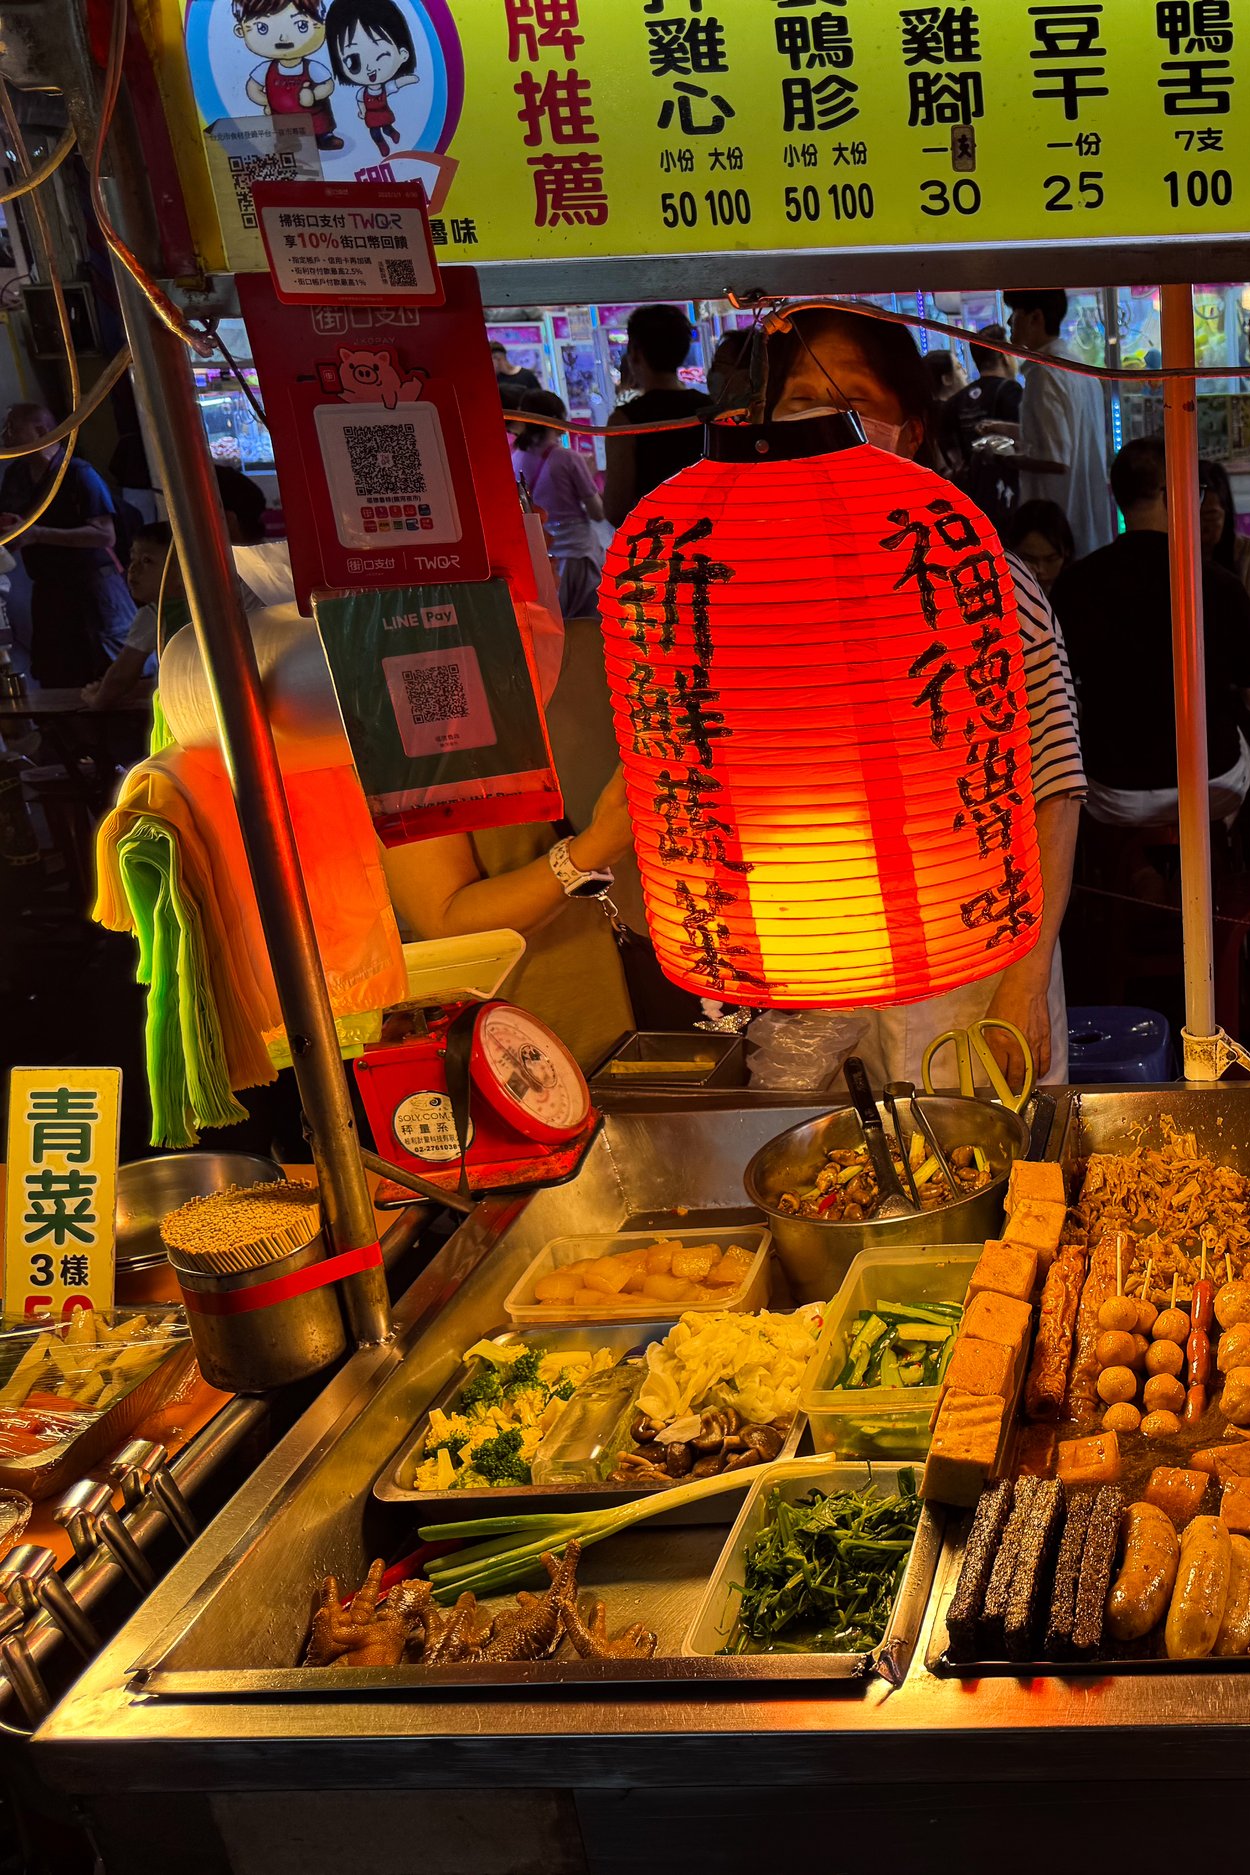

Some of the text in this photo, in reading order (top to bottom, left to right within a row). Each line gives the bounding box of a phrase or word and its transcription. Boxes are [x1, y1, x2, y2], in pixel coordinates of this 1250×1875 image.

[644, 0, 735, 135] 雞心
[775, 0, 859, 132] 鴨胗
[899, 6, 984, 127] 雞腳
[1027, 4, 1109, 120] 豆干
[1156, 0, 1235, 115] 鴨舌
[505, 0, 608, 227] 牌推薦
[783, 141, 867, 167] 小份 大份
[1046, 132, 1101, 156] 一份
[1174, 127, 1224, 152] 7支
[660, 147, 744, 172] 小份 大份
[785, 183, 874, 222] 50 100
[920, 179, 981, 216] 30
[1043, 171, 1104, 211] 25
[1163, 170, 1233, 207] 100
[279, 213, 346, 229] 掃街口支付
[661, 189, 751, 228] 50 100
[311, 305, 420, 335] 街口支付
[347, 557, 395, 573] 街口支付
[382, 610, 452, 630] LINE Pay
[24, 1087, 99, 1245] 青菜
[30, 1253, 89, 1287] 3樣
